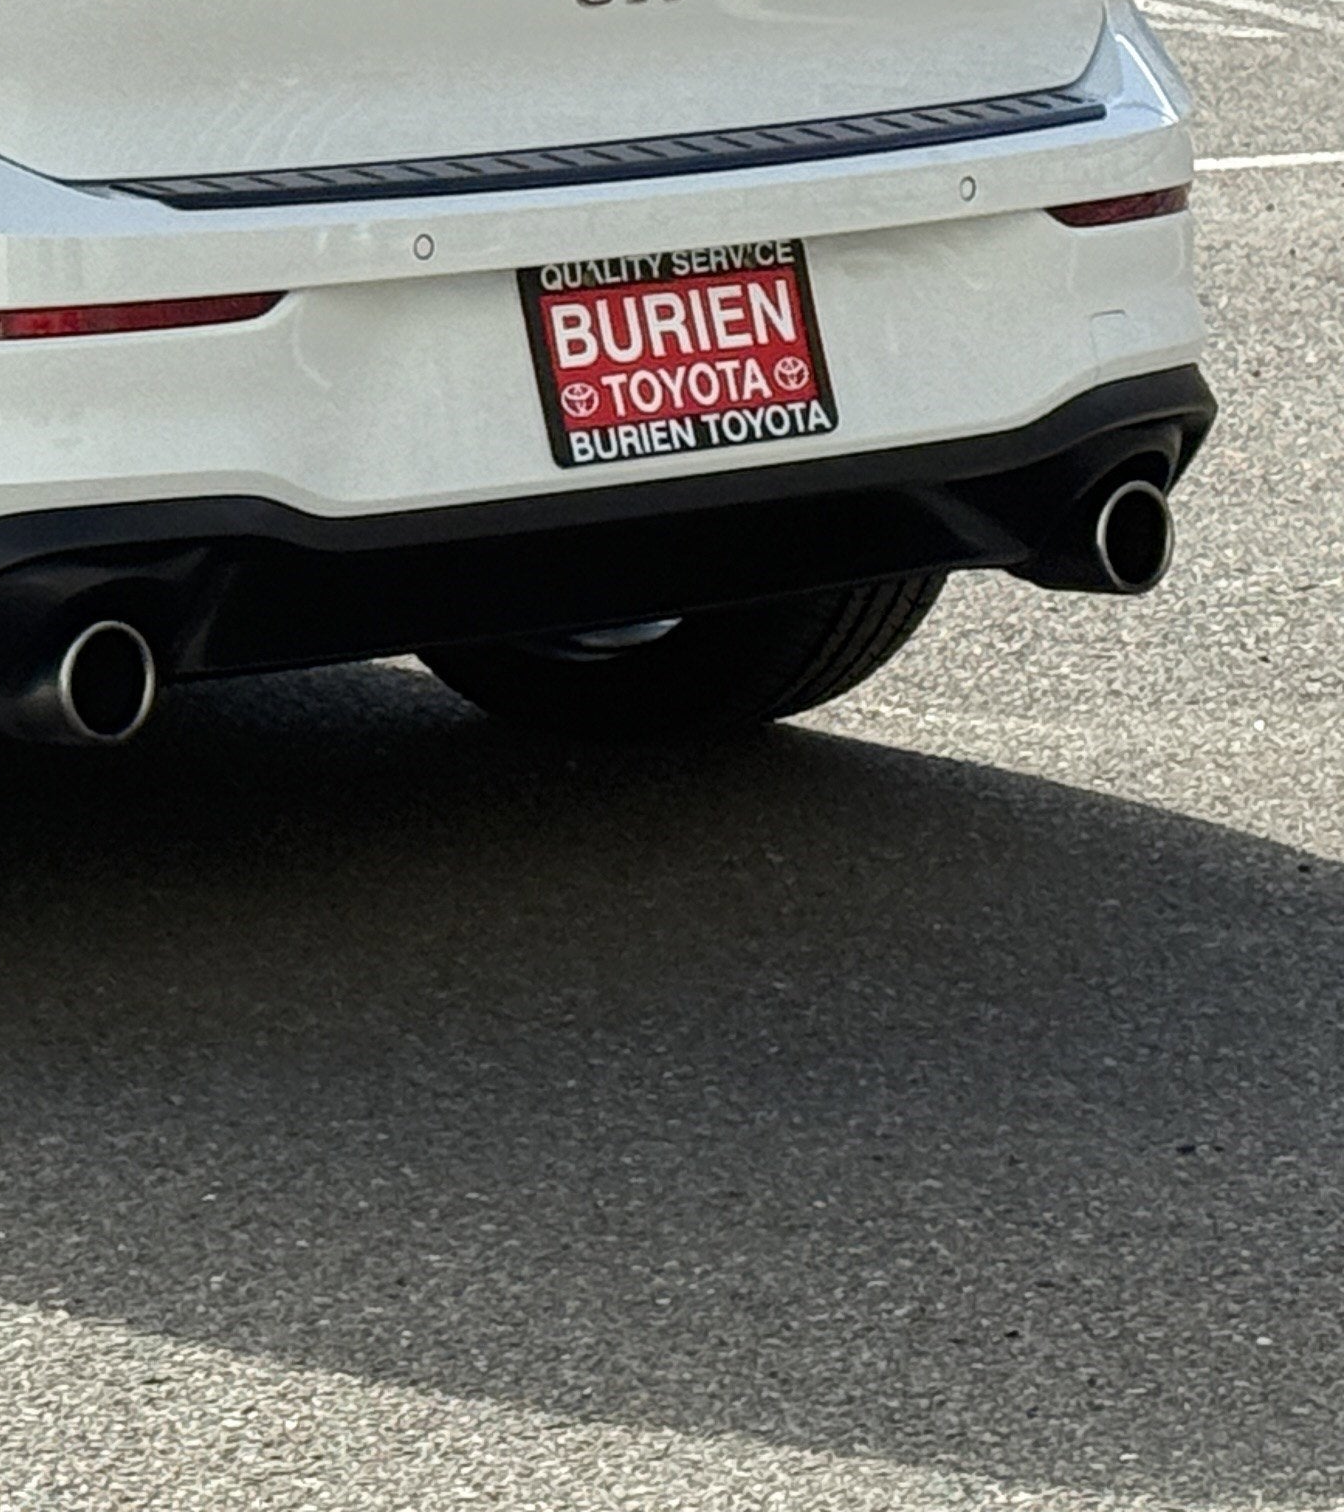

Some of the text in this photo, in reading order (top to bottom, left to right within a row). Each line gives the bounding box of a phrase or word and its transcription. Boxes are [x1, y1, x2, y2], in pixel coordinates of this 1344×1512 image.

[550, 279, 797, 369] BURIEN
[601, 357, 773, 418] TOYOTA
[570, 398, 832, 463] BURIEN TOYOTA
